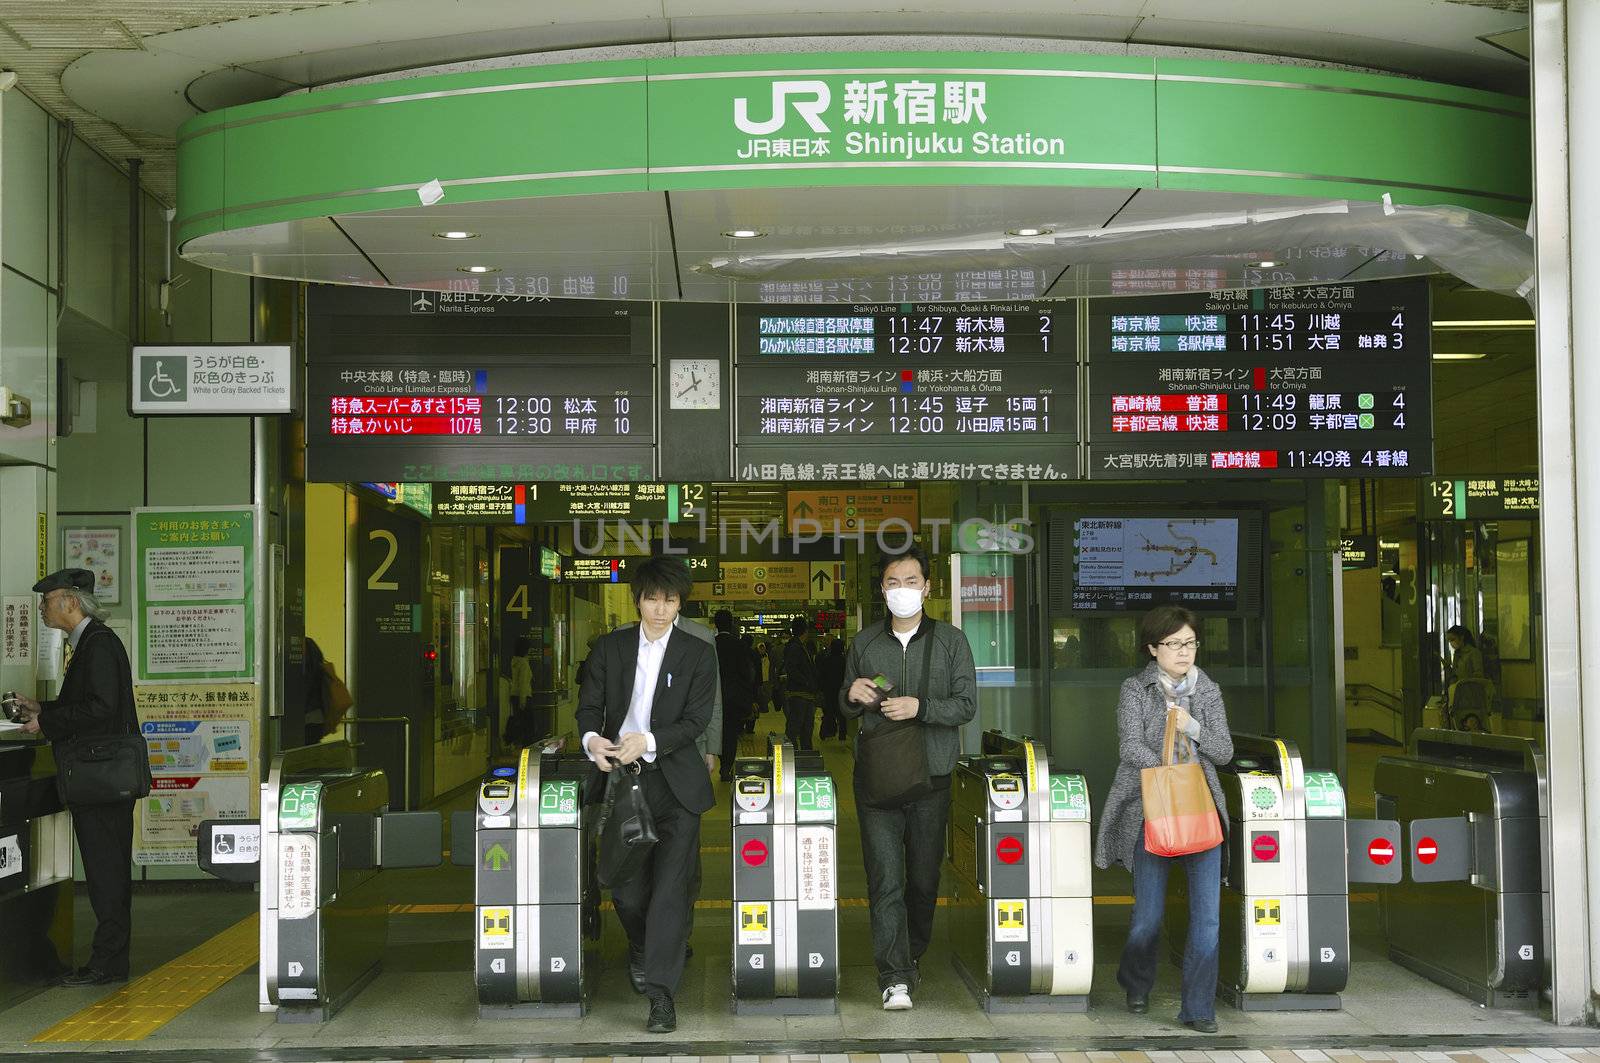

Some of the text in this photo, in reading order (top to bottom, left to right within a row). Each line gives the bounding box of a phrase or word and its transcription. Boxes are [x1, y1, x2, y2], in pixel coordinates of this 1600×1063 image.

[734, 80, 832, 135] JR
[843, 80, 987, 125] 新宿駅
[737, 138, 831, 158] JR東日本
[845, 132, 1065, 159] Shinjuku Station
[1208, 286, 1355, 300] 埼京線 池袋・大宮方面
[439, 304, 495, 315] Narita Express
[879, 304, 897, 313] Line
[916, 304, 927, 313] for
[927, 304, 958, 314] Shibuya,
[983, 304, 989, 313] &
[1014, 303, 1030, 312] Line
[1231, 302, 1249, 311] Line
[1268, 302, 1278, 310] for
[1280, 300, 1318, 310] Ikebukuro
[760, 317, 1051, 334] りんかい線直通各駅停車 11:47 新木場 2
[1111, 313, 1404, 332] 埼京線 快速 11:45 川越 4
[760, 337, 1049, 354] りんかい線直通各駅停車 12:07 新木場 1
[1111, 333, 1403, 352] 埼京線 各駅停車 11:51 大宮 始発 3
[192, 355, 265, 369] うらが白色・
[192, 371, 275, 384] 灰色のきっぷ
[806, 369, 1002, 383] 湘南新宿ライン 横浜・大船方面
[1158, 367, 1322, 381] 湘南新宿ライン 大宮方面
[192, 386, 210, 395] White
[220, 387, 237, 396] Gray
[238, 387, 261, 395] Backed
[262, 387, 286, 395] Tickets
[386, 385, 403, 393] Line
[405, 384, 440, 394] (Limited
[441, 384, 472, 394] Express)
[880, 384, 897, 392] Line
[917, 384, 927, 392] for
[929, 384, 968, 393] Yokohama
[1233, 382, 1250, 391] Line
[1270, 381, 1279, 390] for
[496, 397, 551, 414] 12:00
[564, 397, 597, 414] 松本
[614, 397, 629, 414] 10
[760, 398, 874, 413] 湘南新宿ライン
[889, 397, 943, 413] 11:45
[955, 397, 989, 413] 逗子
[1043, 397, 1049, 412] 1
[1112, 394, 1406, 412] 高崎線 普通 11:49 籠原 4
[331, 418, 629, 434] 特急かいじ 107号 12:30 甲府 10
[760, 417, 874, 434] 湘南新宿ライン
[889, 417, 943, 433] 12:00
[955, 417, 1005, 433] 小田原
[1043, 417, 1049, 432] 1
[1112, 413, 1406, 432] 宇都宮線 快速 12:09 宇都宮 4
[1103, 450, 1409, 468] 大宮駅先着列車 高崎線 11:49発 4番線
[742, 463, 1070, 481] 小田急線・京王線へは通り抜けできません。
[450, 484, 537, 501] 湘南新宿ライン 1
[637, 484, 666, 494] 埼京線
[1468, 480, 1496, 490] 埼京線
[683, 501, 695, 518] 2
[1442, 498, 1454, 515] 2
[149, 520, 241, 531] ご利用のお客さまへ
[160, 532, 230, 543] ご案内とお願い
[367, 529, 399, 590] 2
[618, 559, 626, 569] 4
[505, 584, 532, 620] 4
[542, 783, 559, 809] 入口
[798, 779, 815, 806] 入口
[1051, 778, 1068, 804] 入口
[1304, 775, 1323, 801] 入口
[282, 787, 300, 813] 入口
[300, 844, 311, 908] 小田急線・京王線へは
[802, 837, 815, 901] 通り抜け出来ません
[818, 836, 831, 900] 小田急線・京王線へは
[284, 845, 295, 909] 通り抜け出来ません
[812, 955, 819, 965] 3
[1010, 953, 1017, 963] 3
[1067, 953, 1074, 961] 4
[1267, 951, 1273, 960] 4
[1323, 950, 1331, 960] 5
[1523, 947, 1530, 957] 5
[292, 964, 298, 974] 1
[496, 961, 501, 970] 1
[553, 960, 560, 969] 2
[754, 956, 761, 966] 2
